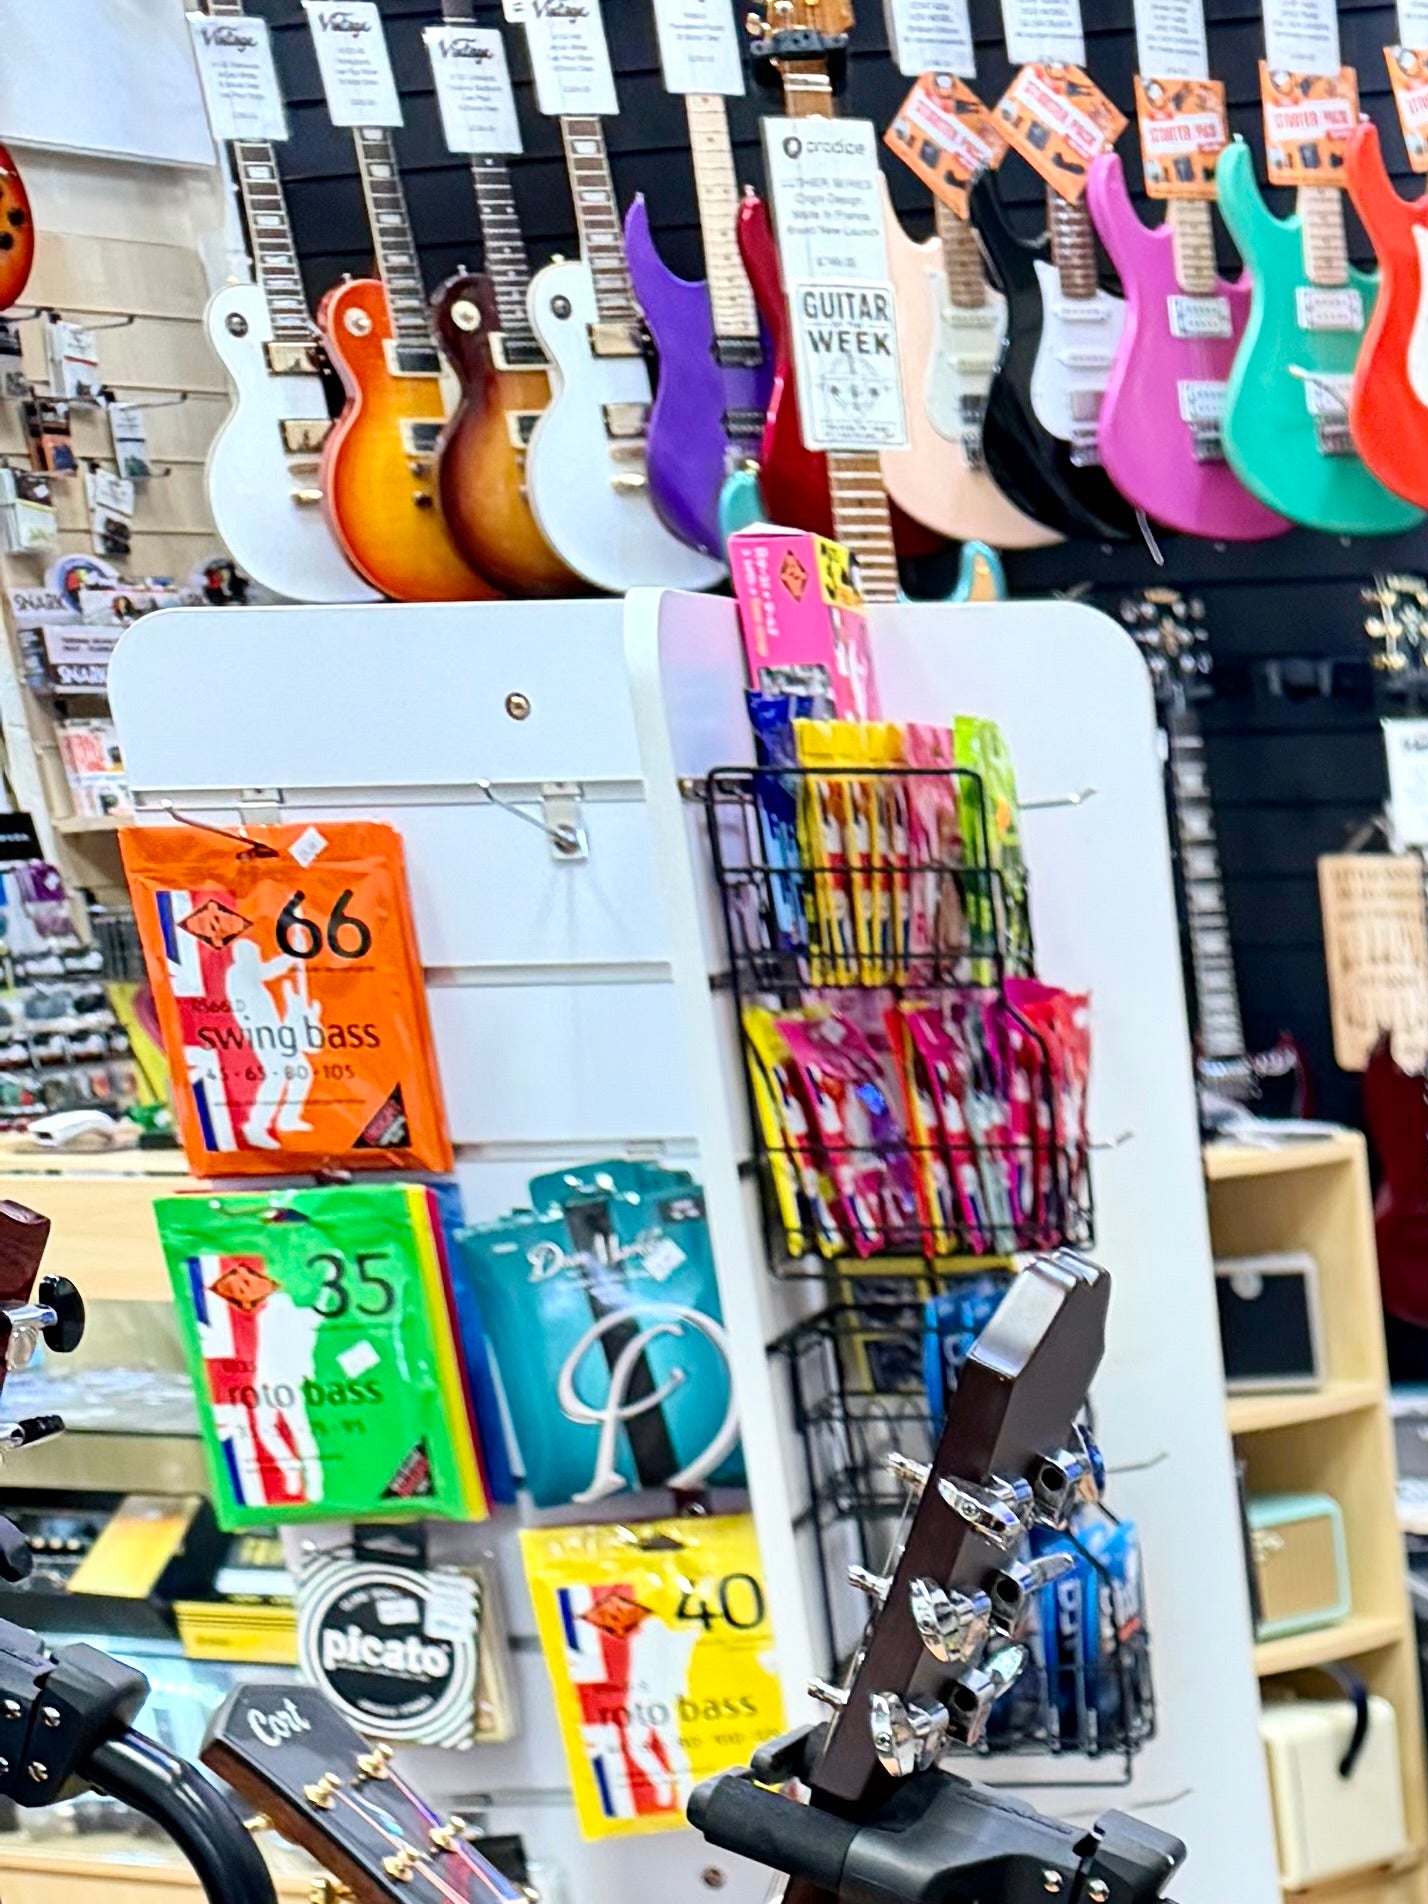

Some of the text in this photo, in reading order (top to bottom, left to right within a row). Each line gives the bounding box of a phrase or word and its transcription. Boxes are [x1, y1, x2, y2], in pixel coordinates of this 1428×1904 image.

[803, 291, 891, 322] GUITAR
[808, 329, 892, 357] WEEK
[275, 889, 372, 959] 66
[198, 1014, 381, 1057] swing bass
[306, 1252, 396, 1319] 35
[302, 1374, 384, 1407] bass
[677, 1573, 766, 1631] 40
[323, 1623, 450, 1678] picato
[248, 1698, 311, 1748] Cort
[677, 1693, 758, 1722] bass
